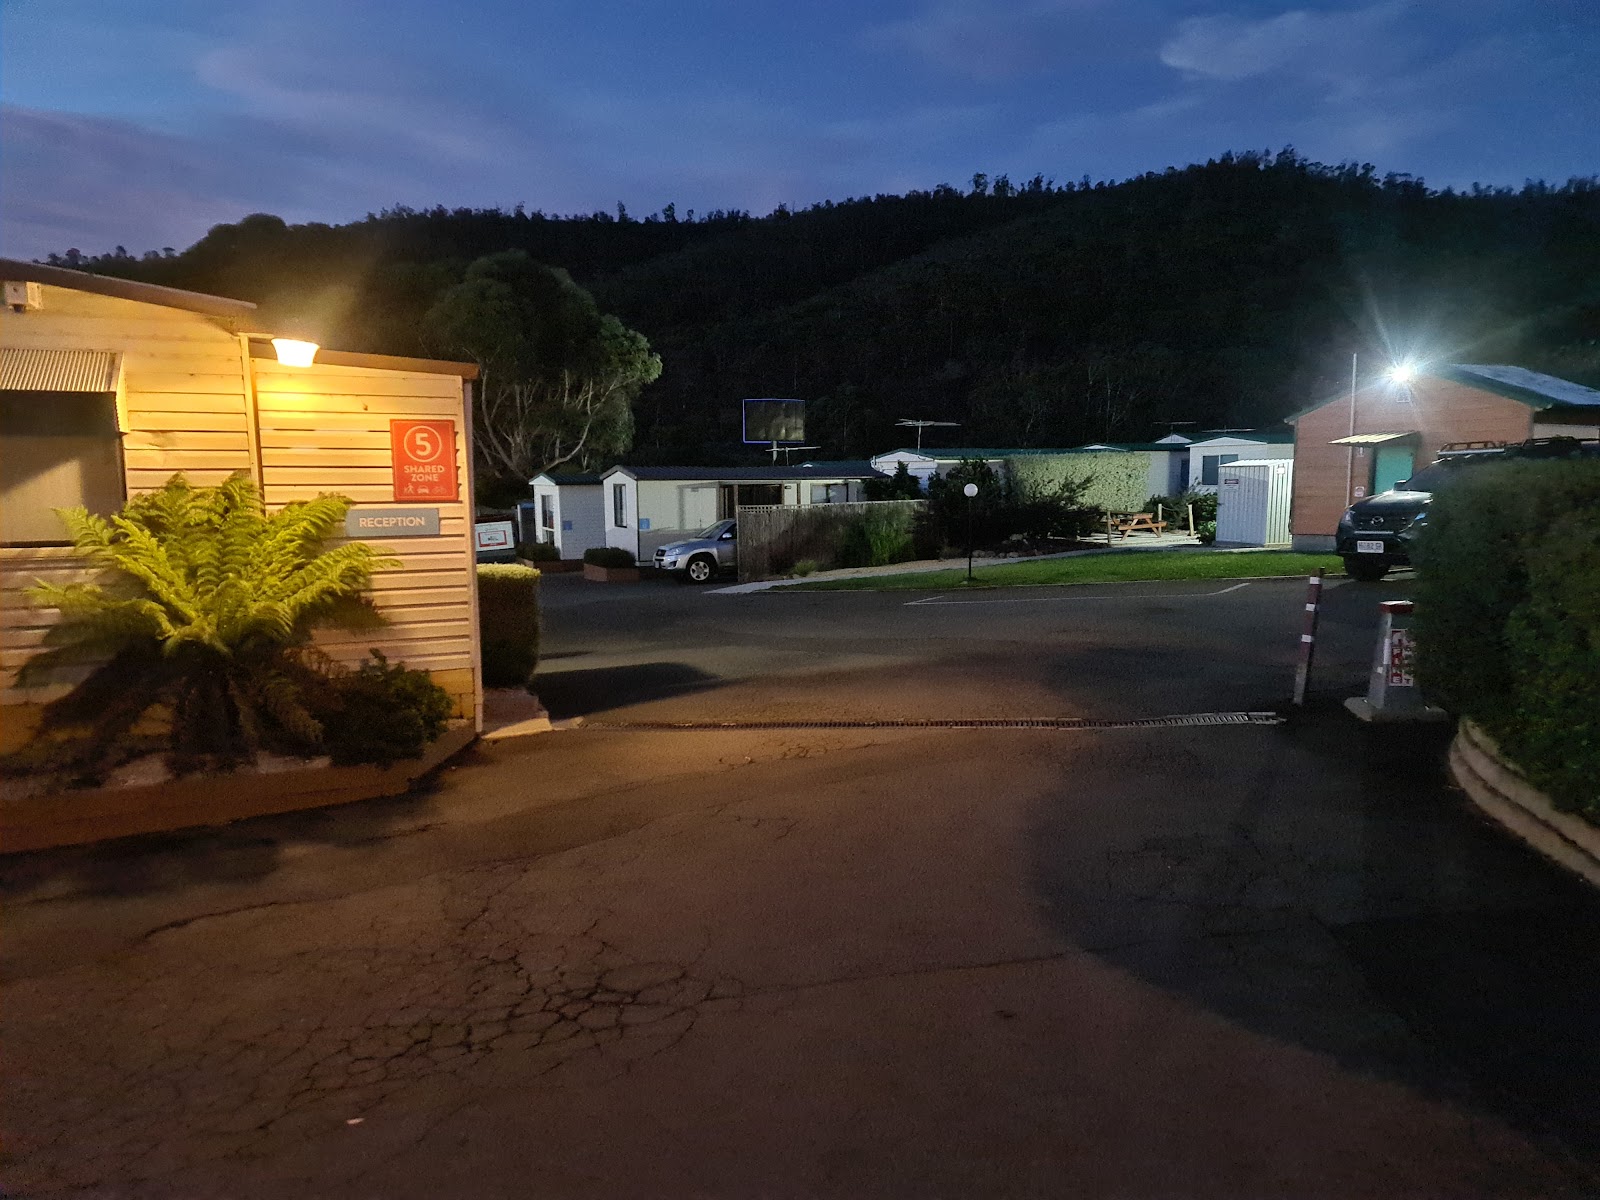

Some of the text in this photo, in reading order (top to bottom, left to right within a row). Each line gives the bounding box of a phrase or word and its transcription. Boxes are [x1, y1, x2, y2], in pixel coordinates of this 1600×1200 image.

[415, 432, 431, 456] 5
[403, 465, 445, 473] SHARED
[411, 473, 439, 482] ZONE
[359, 516, 426, 528] RECEPTION
